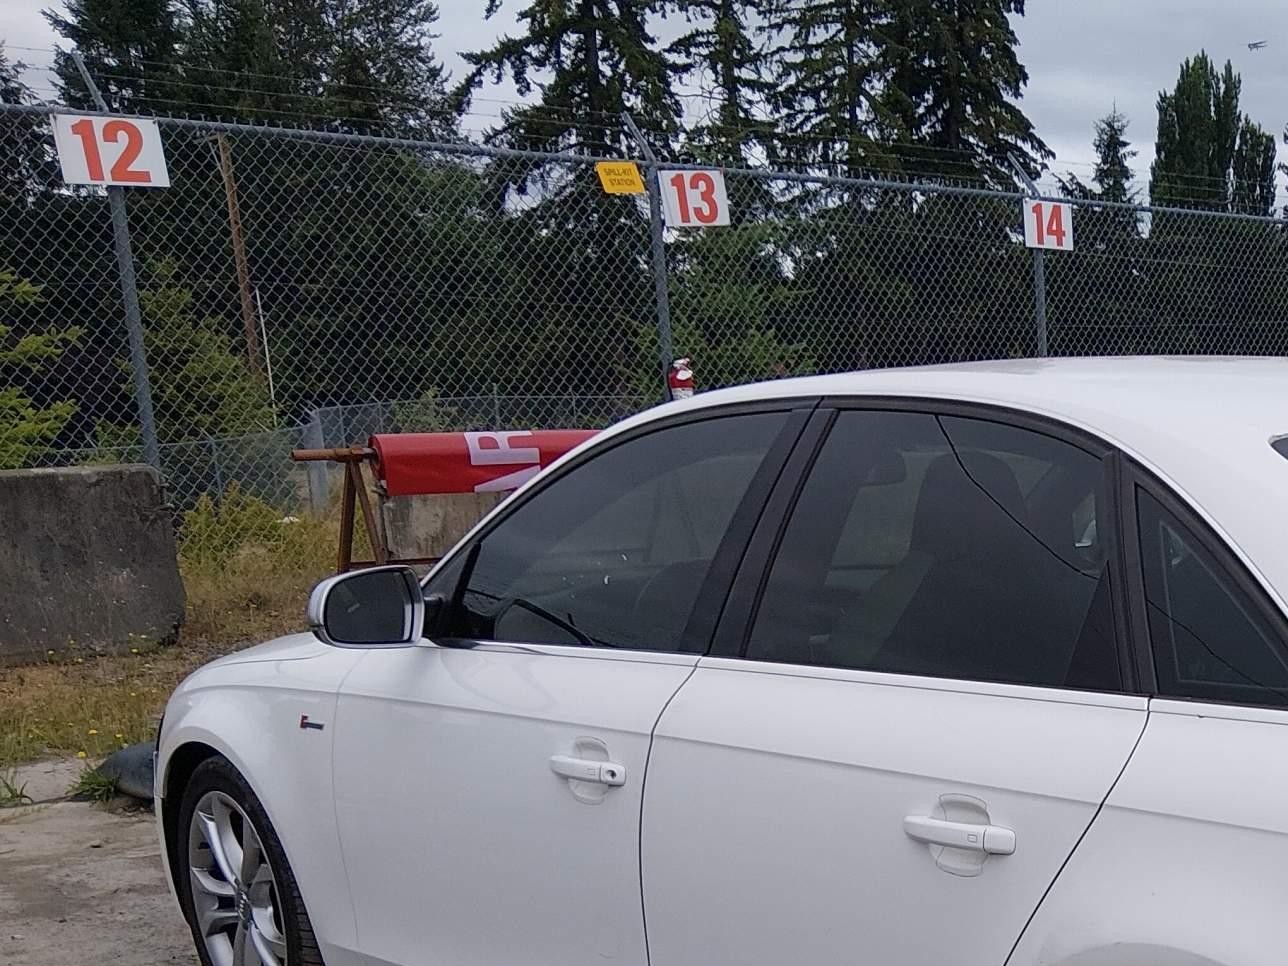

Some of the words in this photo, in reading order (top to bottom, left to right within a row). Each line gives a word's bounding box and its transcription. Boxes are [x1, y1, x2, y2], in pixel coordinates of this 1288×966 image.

[71, 119, 152, 183] 12
[670, 171, 719, 224] 13
[1031, 202, 1066, 247] 14
